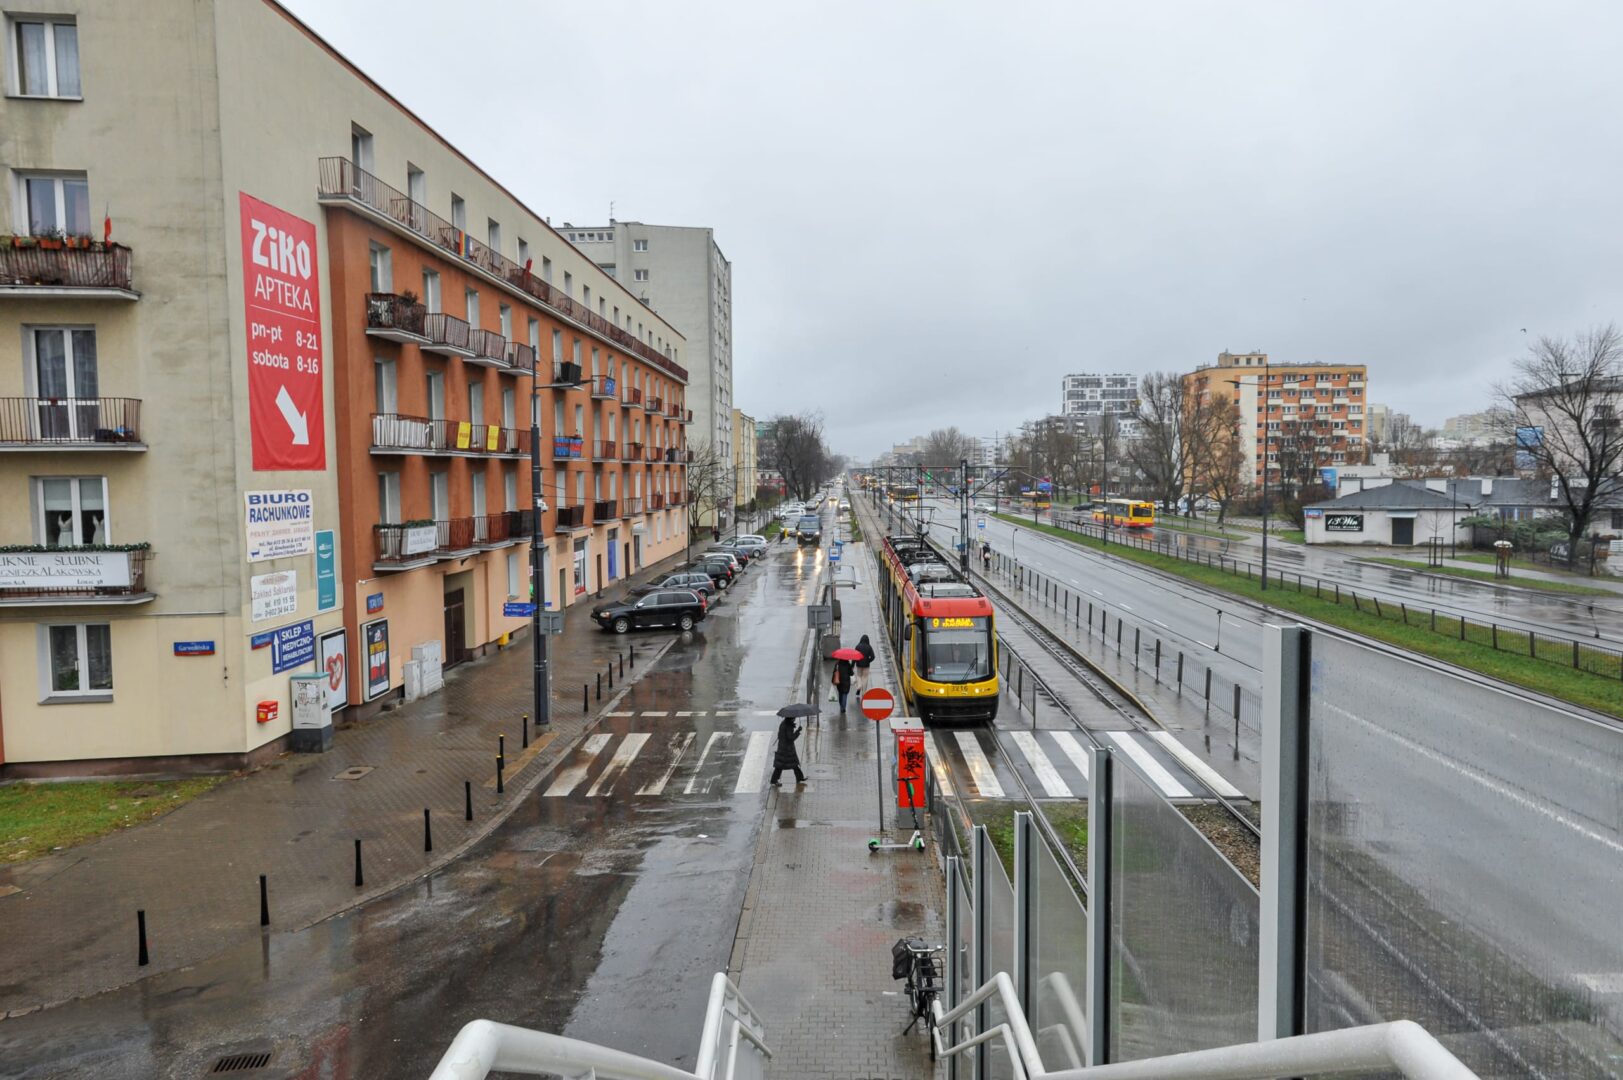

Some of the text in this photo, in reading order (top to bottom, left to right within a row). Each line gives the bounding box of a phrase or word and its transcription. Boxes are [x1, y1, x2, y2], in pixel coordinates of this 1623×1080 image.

[254, 274, 313, 312] APTEKA
[251, 322, 318, 351] pn-pt 8-21
[252, 350, 319, 374] sobota 8-16
[248, 493, 309, 505] BIURO
[249, 504, 310, 523] RACHUNKOWE
[0, 556, 38, 566] UKNIE
[932, 618, 940, 627] 9
[281, 626, 302, 641] SKLEP
[282, 636, 313, 652] MEDYCZNO-
